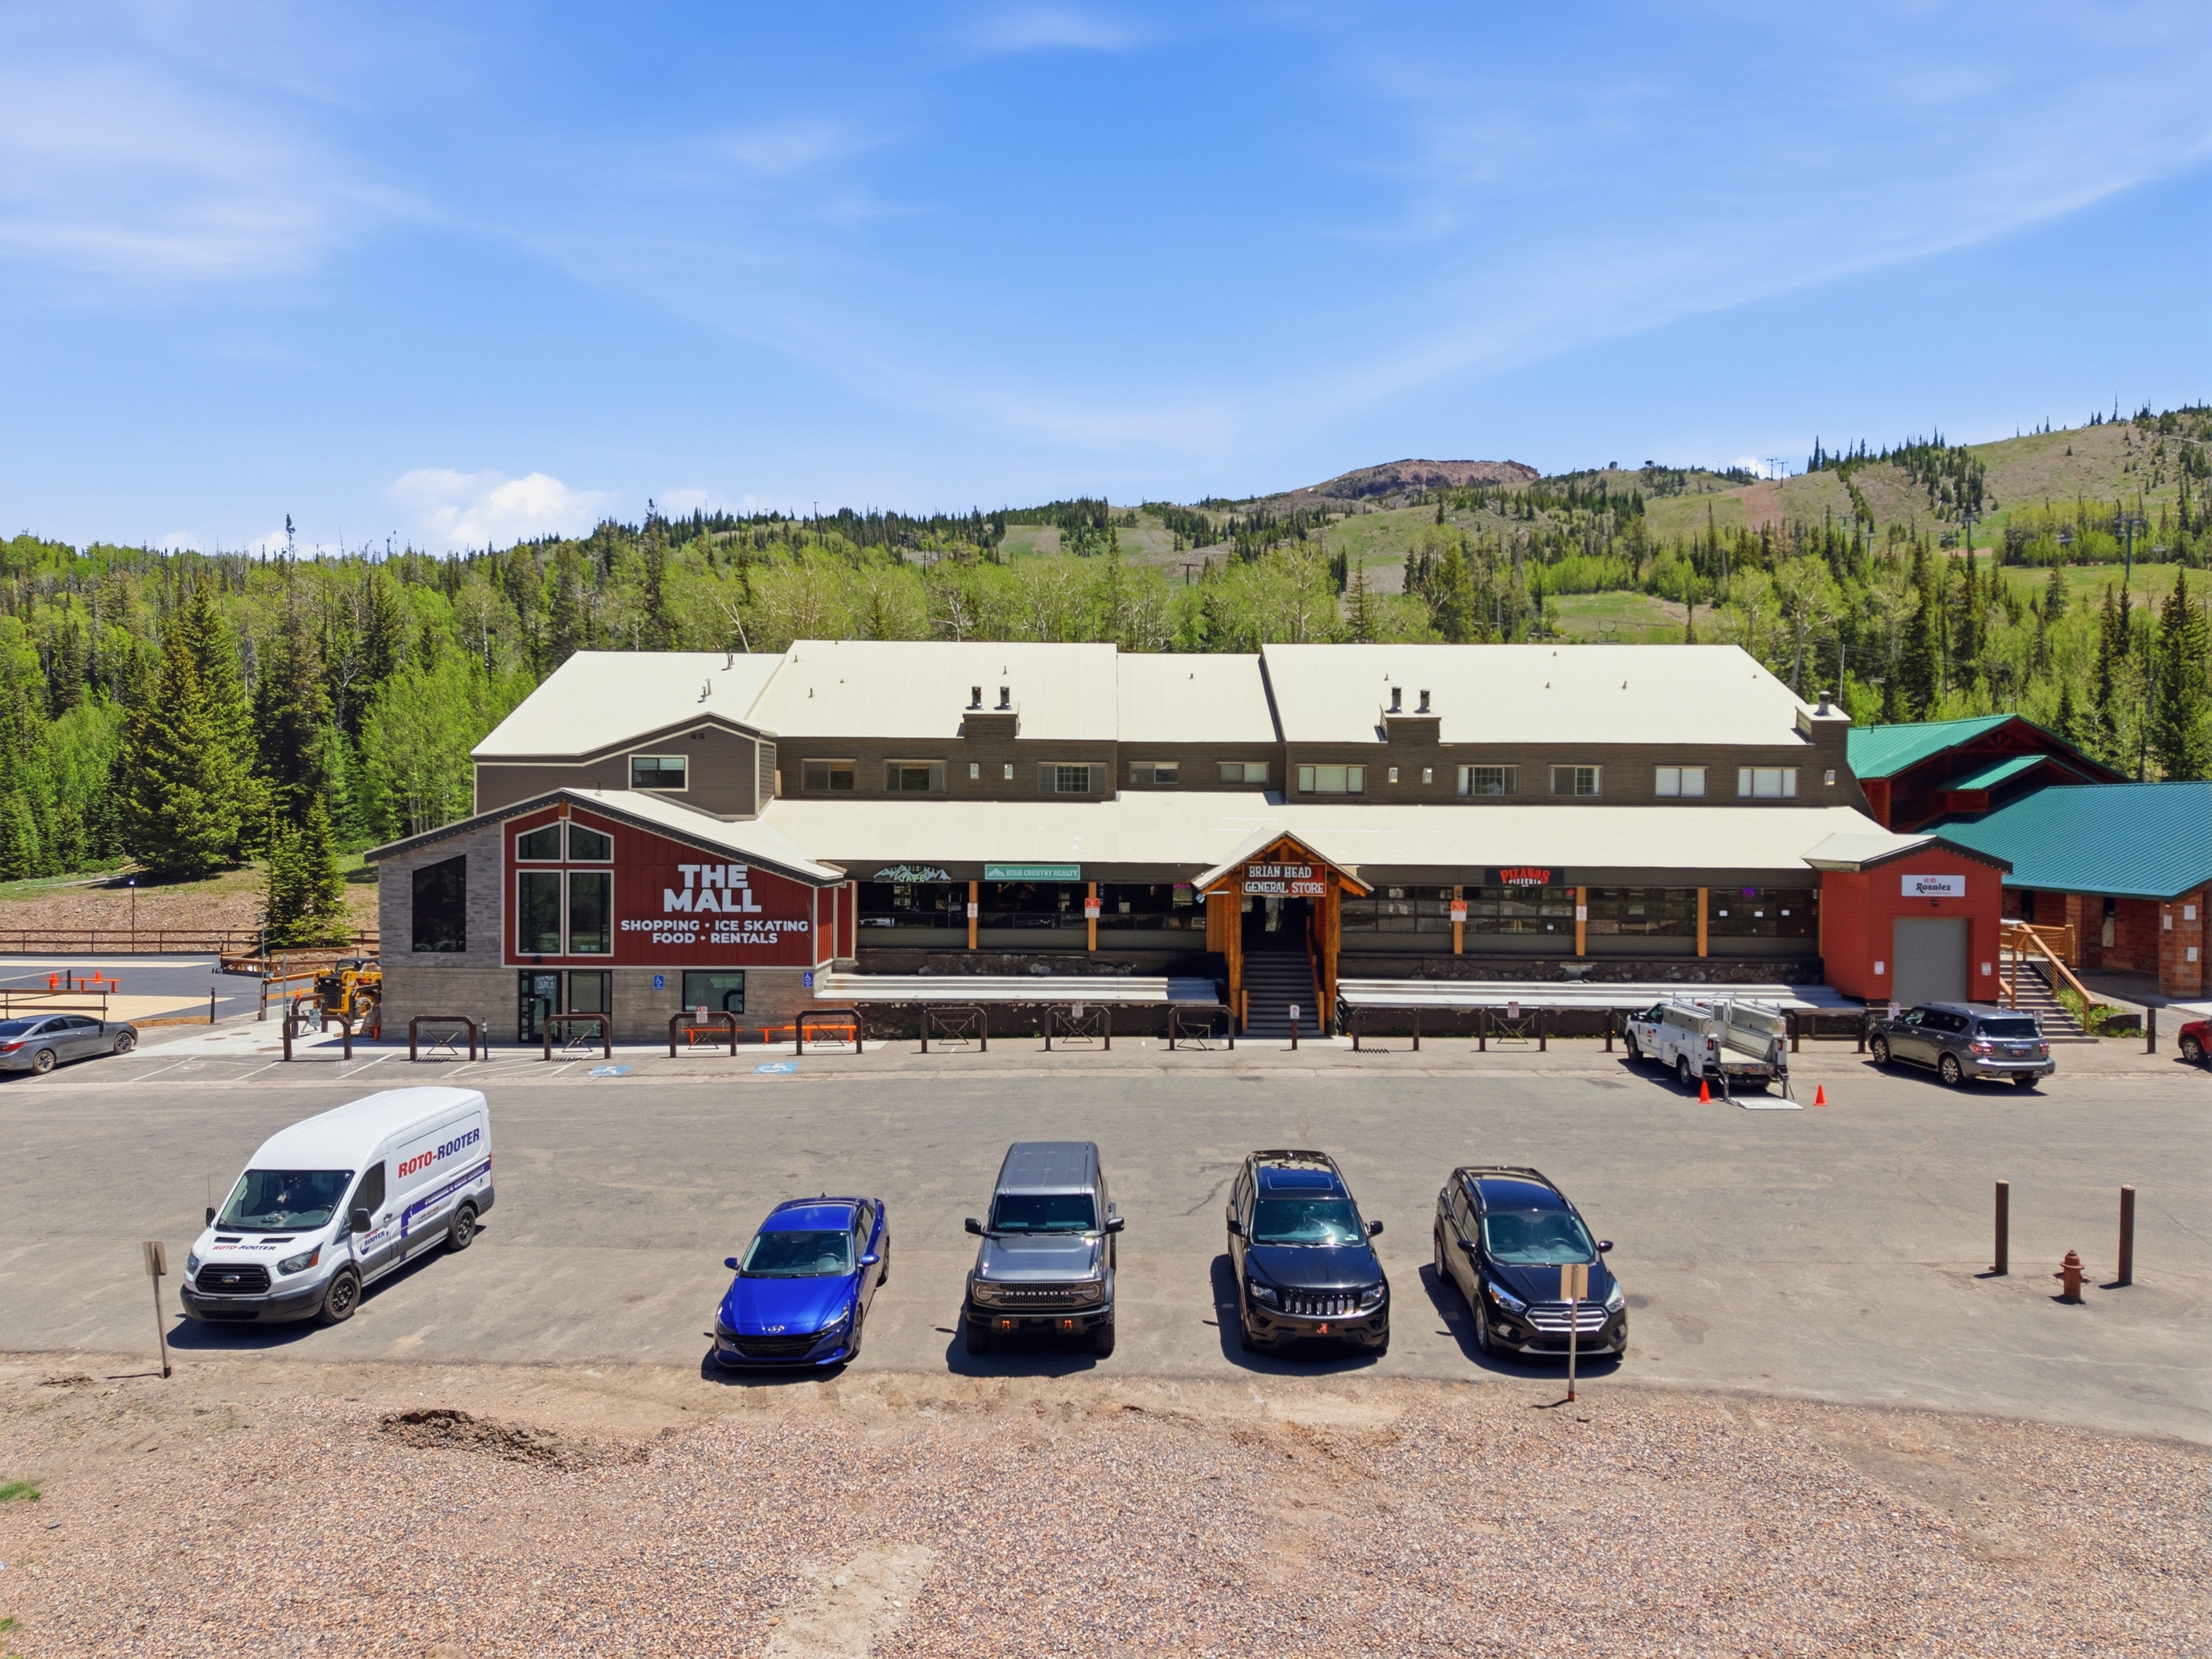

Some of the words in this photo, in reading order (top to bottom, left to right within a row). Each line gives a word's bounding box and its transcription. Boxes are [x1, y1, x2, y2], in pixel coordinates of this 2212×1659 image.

[678, 865, 748, 888] THE
[1249, 866, 1281, 878] BRIAN
[1284, 866, 1312, 879] HEAD
[1245, 881, 1289, 893] GENERAL
[1292, 882, 1324, 894] STORE
[664, 889, 762, 913] MALL
[621, 920, 700, 931] SHOPPING
[715, 920, 740, 931] ICE
[743, 920, 808, 932] SKATING
[652, 933, 696, 943] FOOD
[711, 933, 778, 944] RENTALS
[399, 1128, 480, 1179] ROTO-ROOTER
